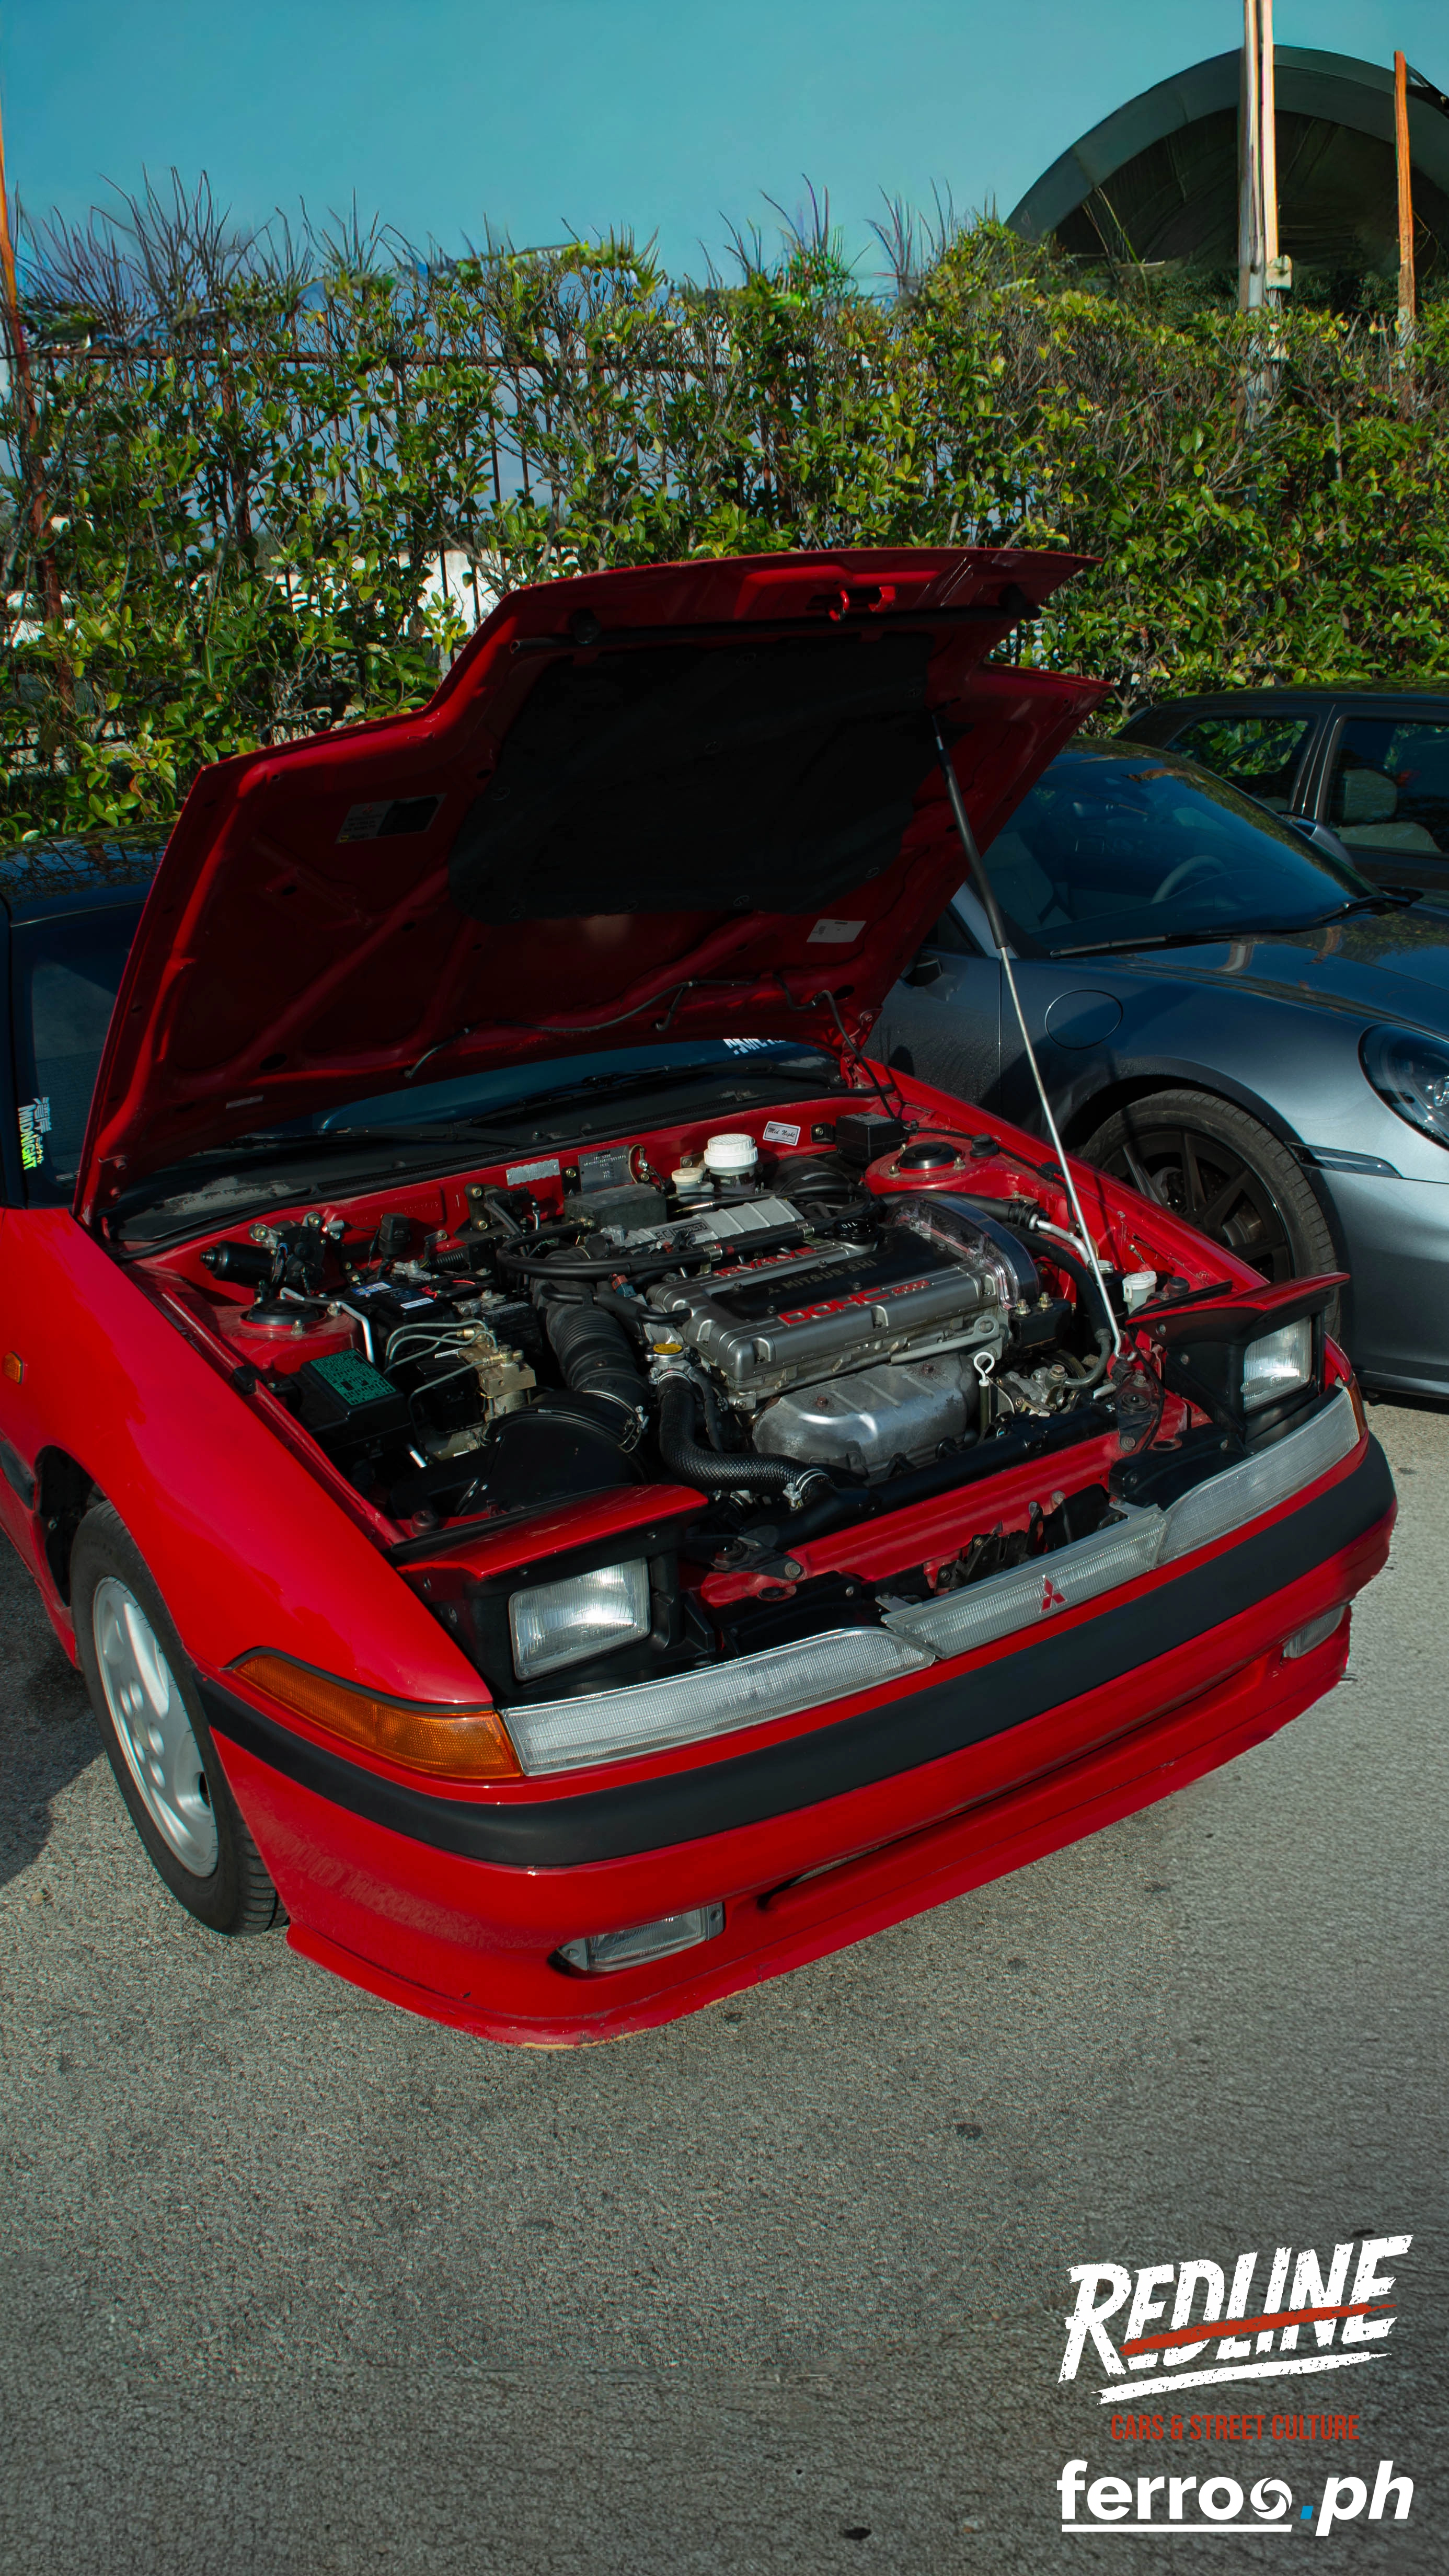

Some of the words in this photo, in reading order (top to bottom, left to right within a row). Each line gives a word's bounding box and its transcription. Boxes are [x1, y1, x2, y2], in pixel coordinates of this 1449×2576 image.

[18, 1104, 37, 1170] MIDNIGHT
[778, 1287, 889, 1327] DOHC
[891, 1279, 930, 1296] 2000
